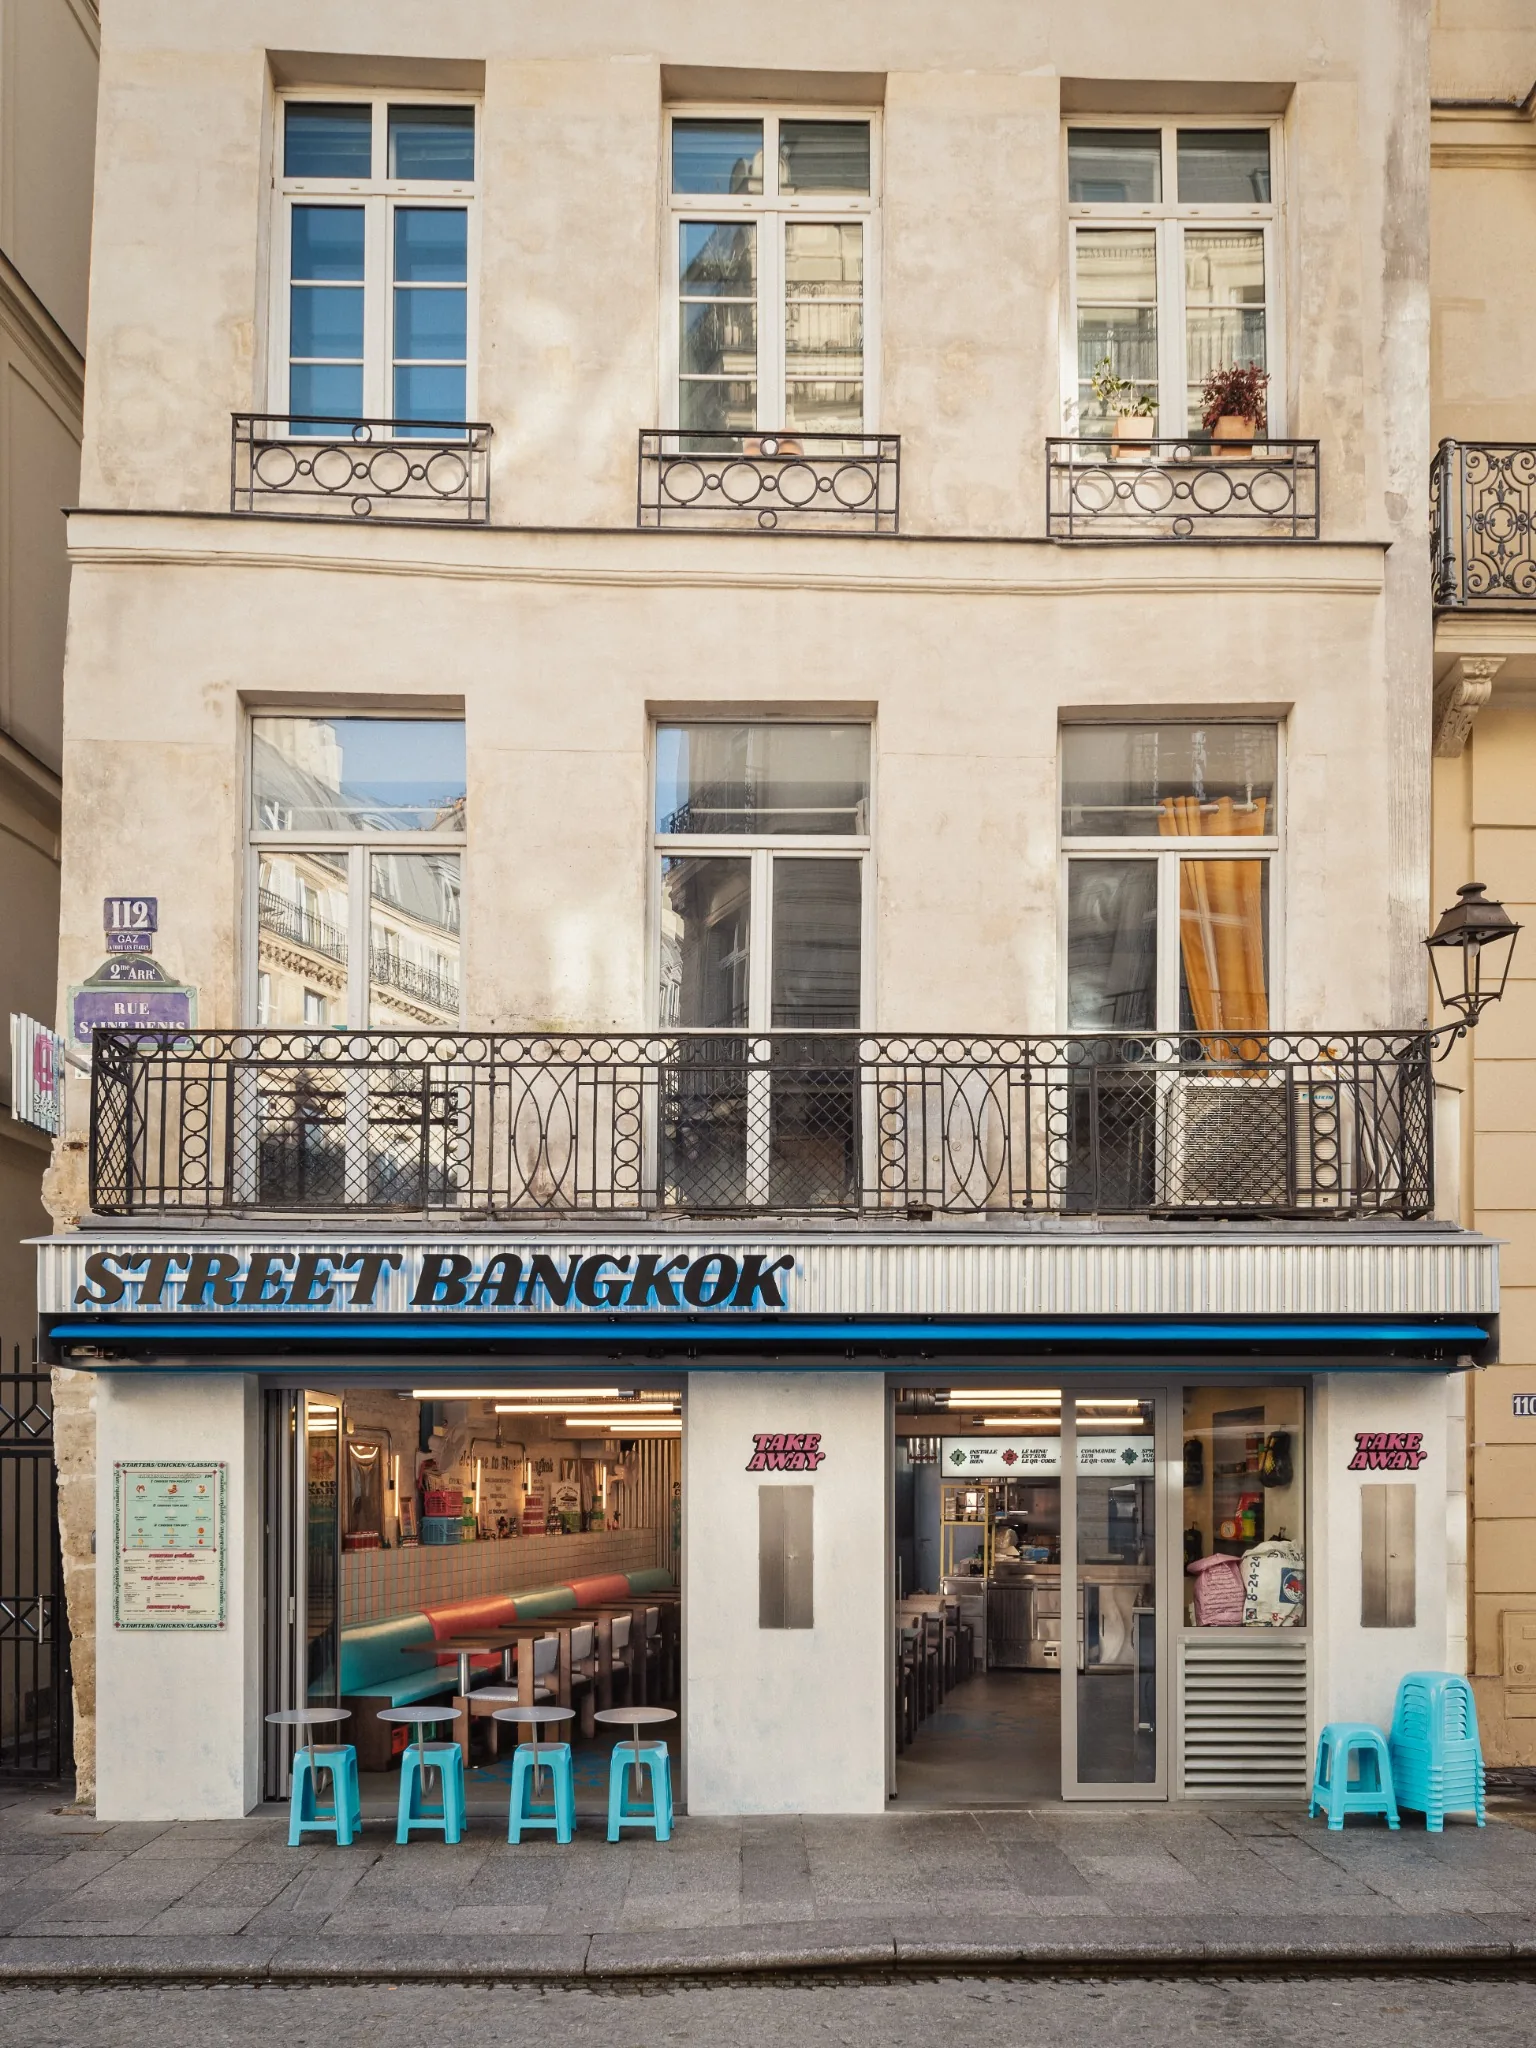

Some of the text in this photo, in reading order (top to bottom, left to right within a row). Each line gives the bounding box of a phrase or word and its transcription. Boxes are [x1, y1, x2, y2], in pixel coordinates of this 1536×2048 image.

[111, 900, 148, 928] 112
[117, 934, 139, 944] GAZ
[114, 1002, 150, 1015] RUE
[79, 1021, 185, 1034] SAINT DENIS
[73, 1251, 796, 1308] STREET BANGKOK
[752, 1433, 822, 1453] TAKE
[1355, 1432, 1424, 1452] TAKE
[745, 1451, 826, 1471] AWAY
[1347, 1450, 1428, 1470] AWAY
[1247, 1556, 1261, 1601] 8-24-24
